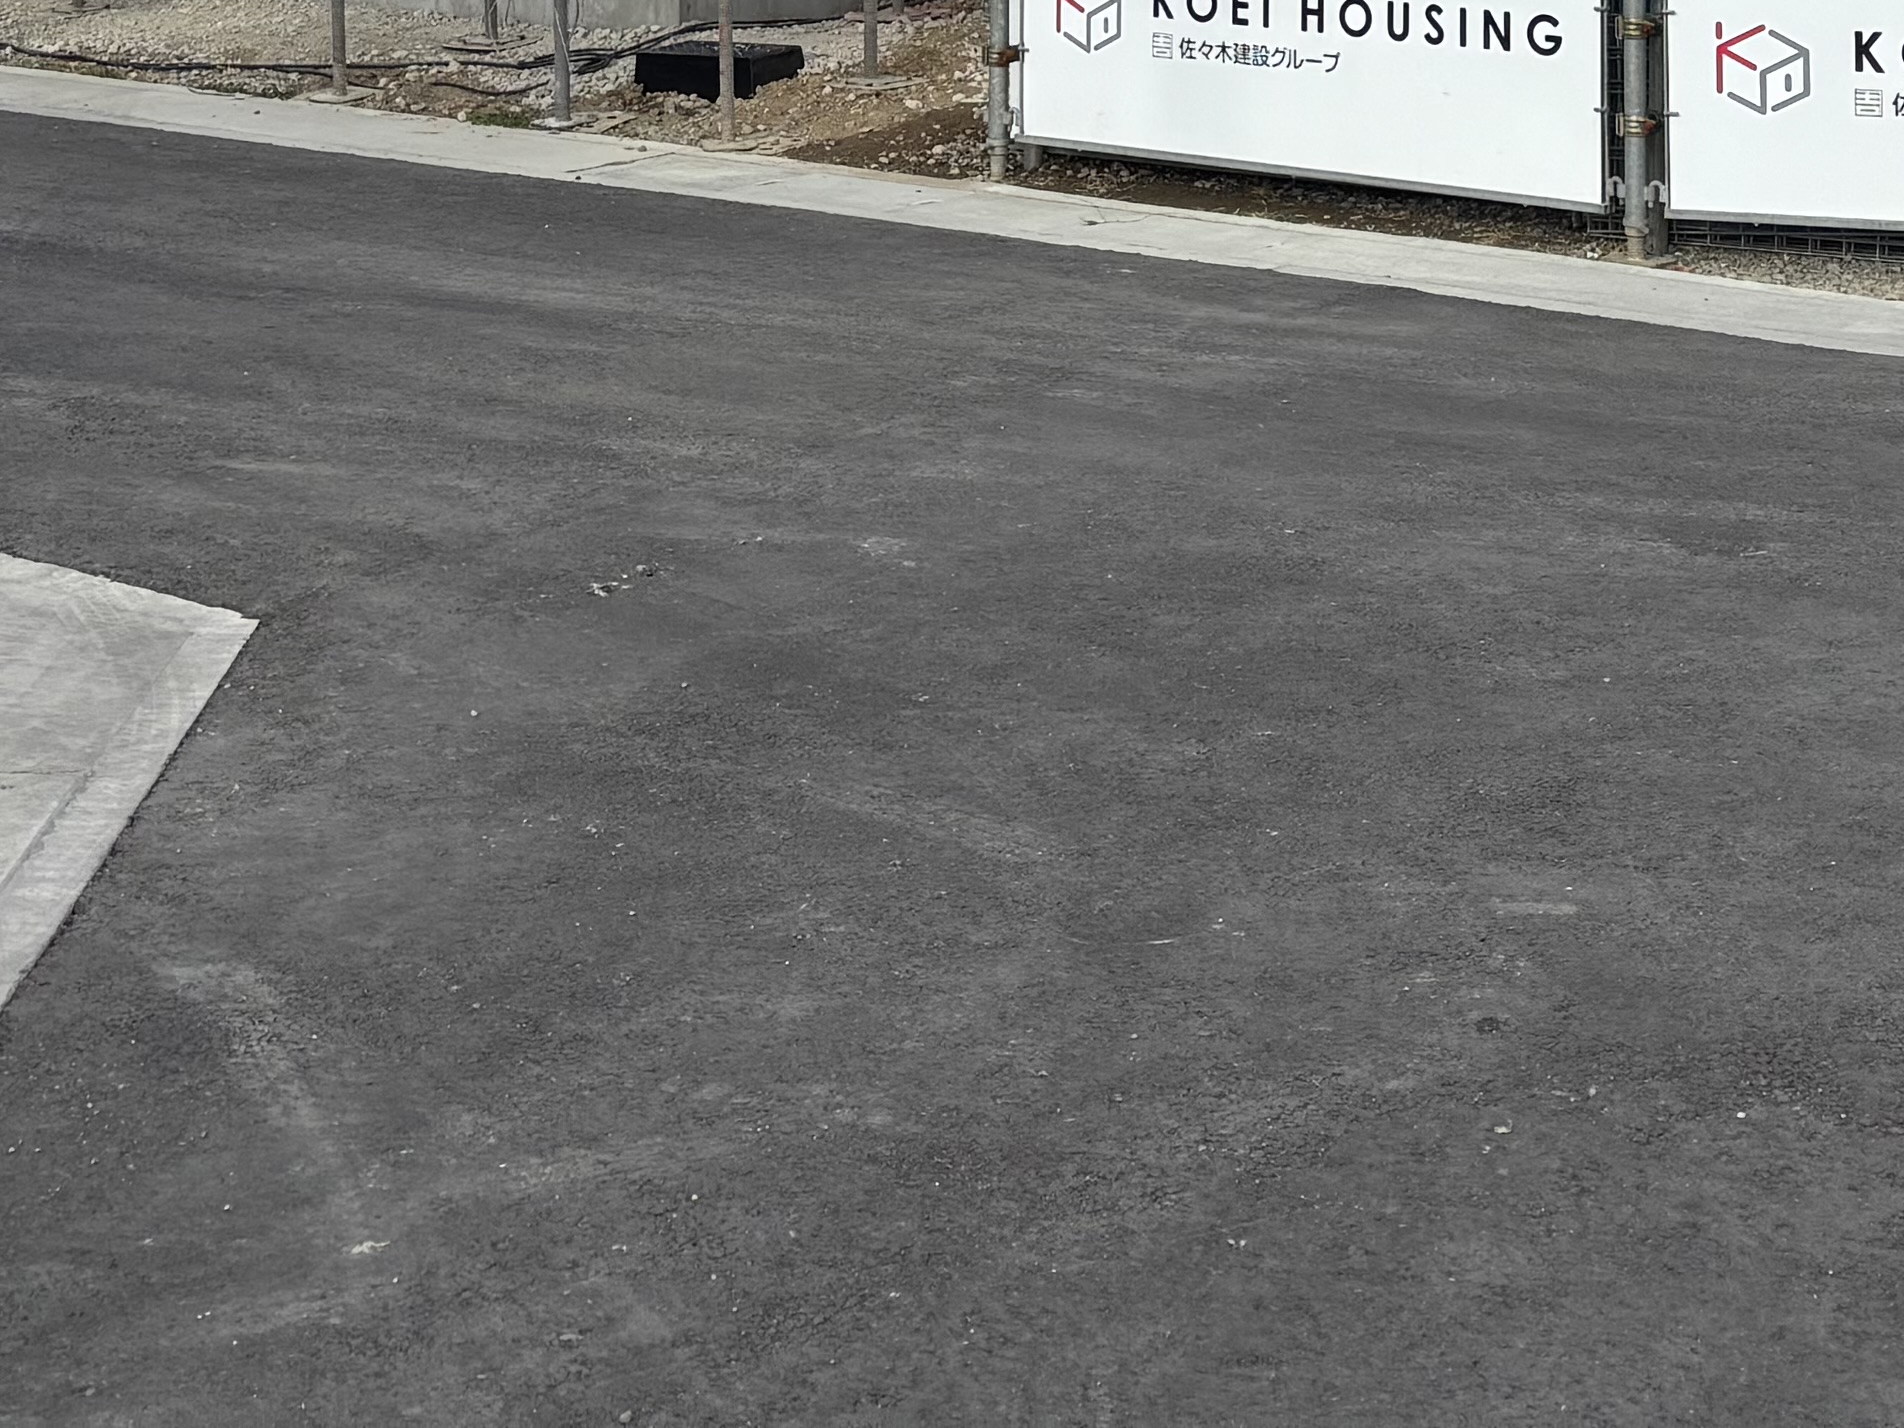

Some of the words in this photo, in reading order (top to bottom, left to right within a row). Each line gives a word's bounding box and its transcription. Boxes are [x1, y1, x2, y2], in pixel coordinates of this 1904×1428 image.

[1178, 37, 1342, 74] 佐々木建設グループ
